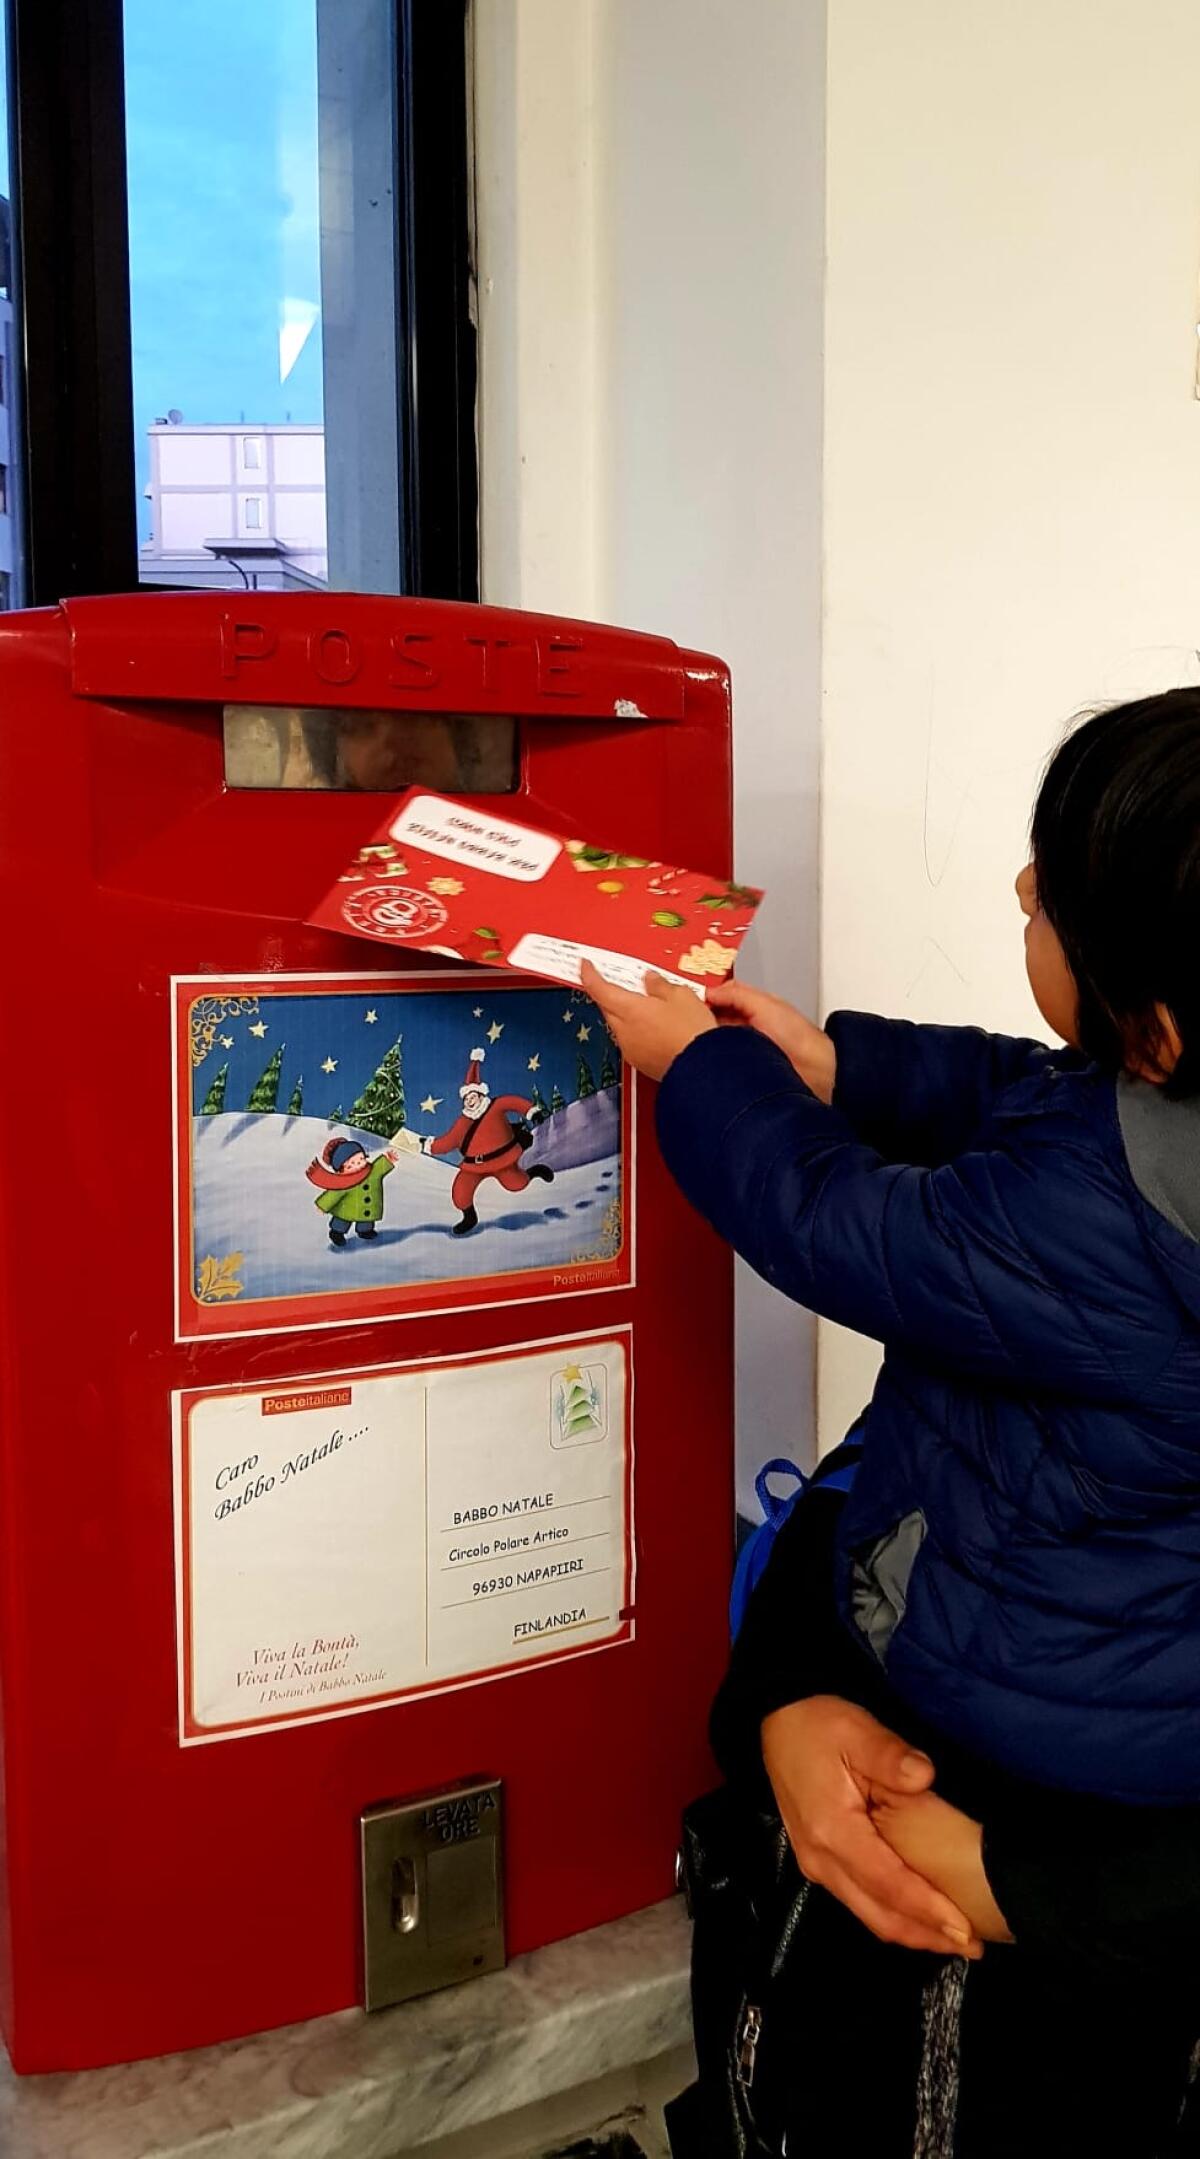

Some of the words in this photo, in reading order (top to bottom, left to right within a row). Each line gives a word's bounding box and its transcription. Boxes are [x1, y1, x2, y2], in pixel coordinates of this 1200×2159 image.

[219, 614, 584, 697] POSTE
[214, 1475, 275, 1520] Babbo
[280, 1430, 344, 1484] Natale
[215, 1454, 259, 1490] Caro
[453, 1505, 498, 1524] BABBO
[502, 1493, 554, 1515] NATALE
[449, 1542, 490, 1561] Circolo
[494, 1537, 530, 1552] Polare
[533, 1528, 569, 1543] Artico
[472, 1576, 513, 1596] 96930
[516, 1559, 584, 1585] NAPAPIIRI
[514, 1608, 587, 1637] FINLANDIA
[253, 1648, 286, 1665] Viva
[291, 1642, 305, 1659] la
[312, 1634, 360, 1655] Bontà,
[236, 1667, 269, 1687] Viva
[274, 1663, 286, 1681] il
[290, 1653, 349, 1679] Natale!
[306, 1682, 316, 1694] di
[319, 1675, 351, 1692] Babbo
[353, 1669, 388, 1686] Natale
[423, 1791, 497, 1830] LEVATA
[441, 1818, 481, 1842] ORE
